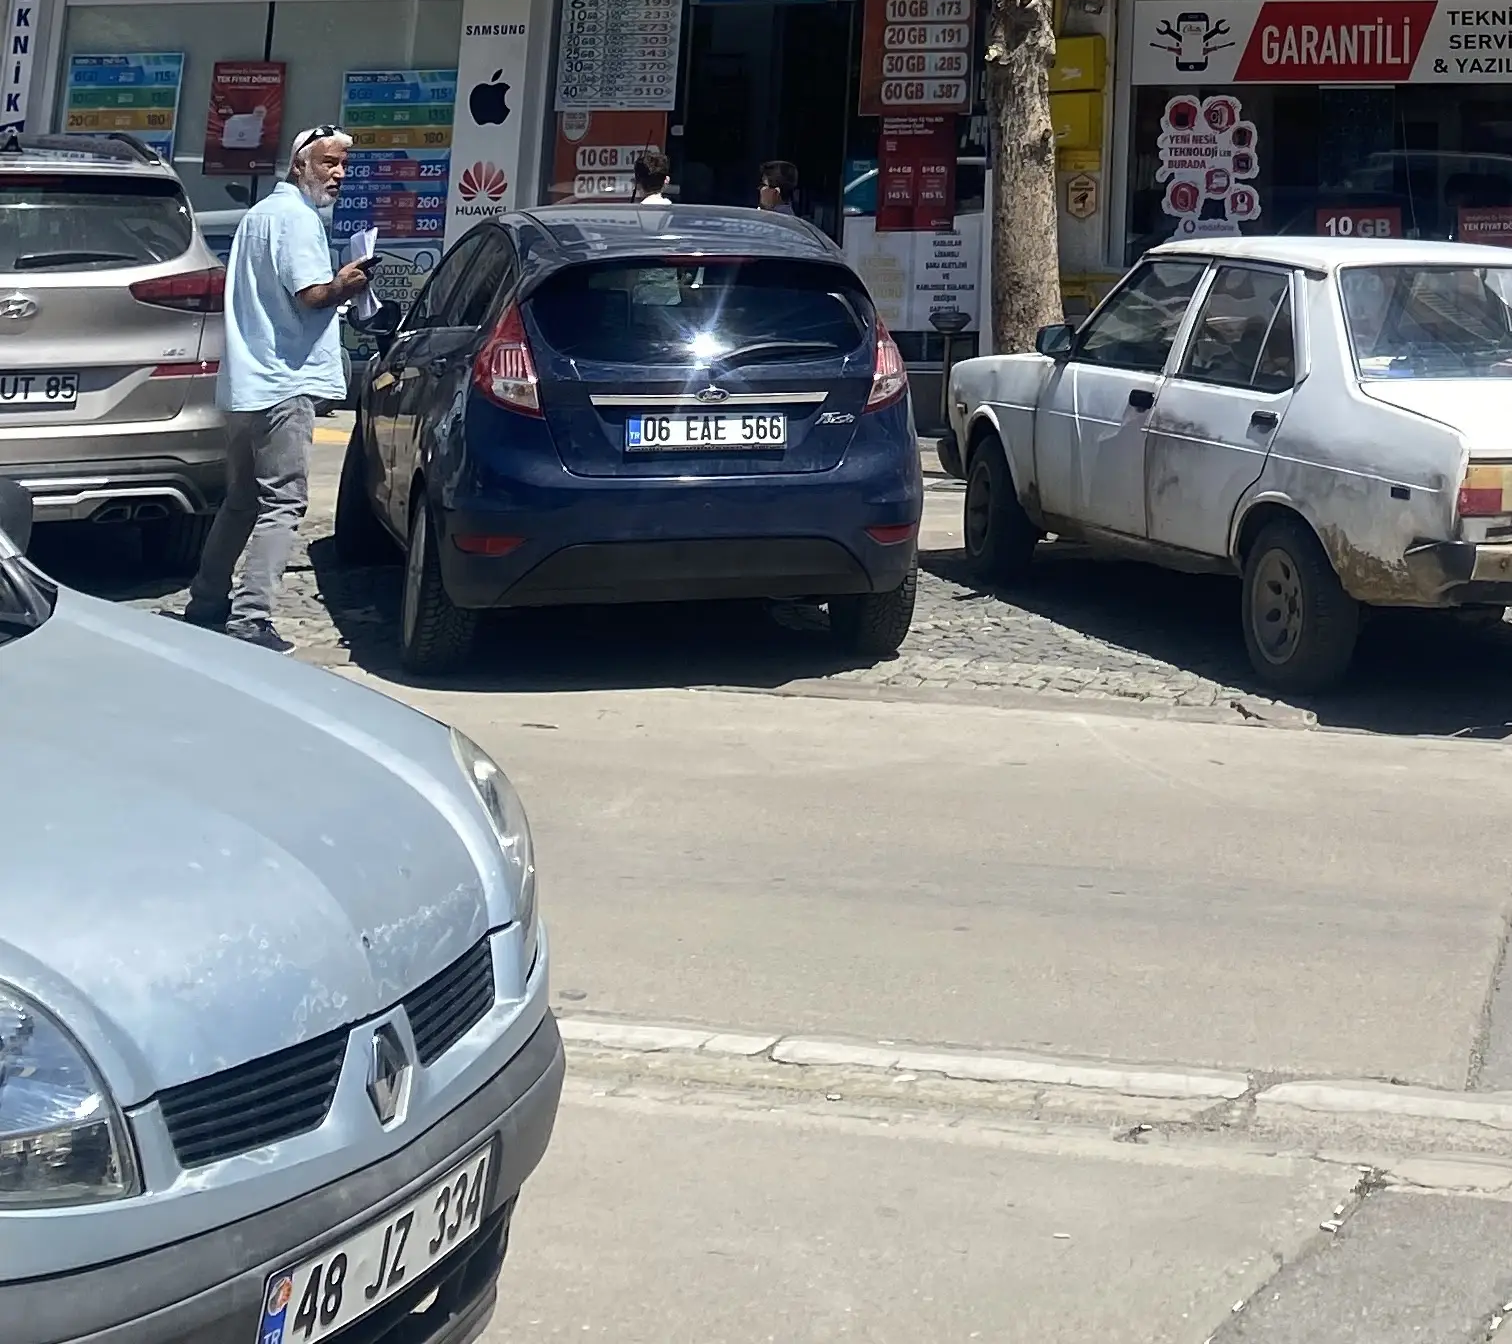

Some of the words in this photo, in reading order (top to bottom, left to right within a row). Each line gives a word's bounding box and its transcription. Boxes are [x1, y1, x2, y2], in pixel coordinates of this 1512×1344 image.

[465, 23, 526, 37] SAMSUNG
[1260, 14, 1412, 67] GARANTİLİ
[1433, 56, 1449, 74] &
[1167, 159, 1207, 169] BURADA
[1324, 215, 1353, 237] 10
[45, 375, 77, 400] 85
[643, 416, 671, 442] 06
[685, 416, 727, 441] EAE
[741, 415, 782, 440] 566
[291, 1251, 348, 1340] 48
[364, 1210, 416, 1301] JZ
[429, 1156, 487, 1256] 334
